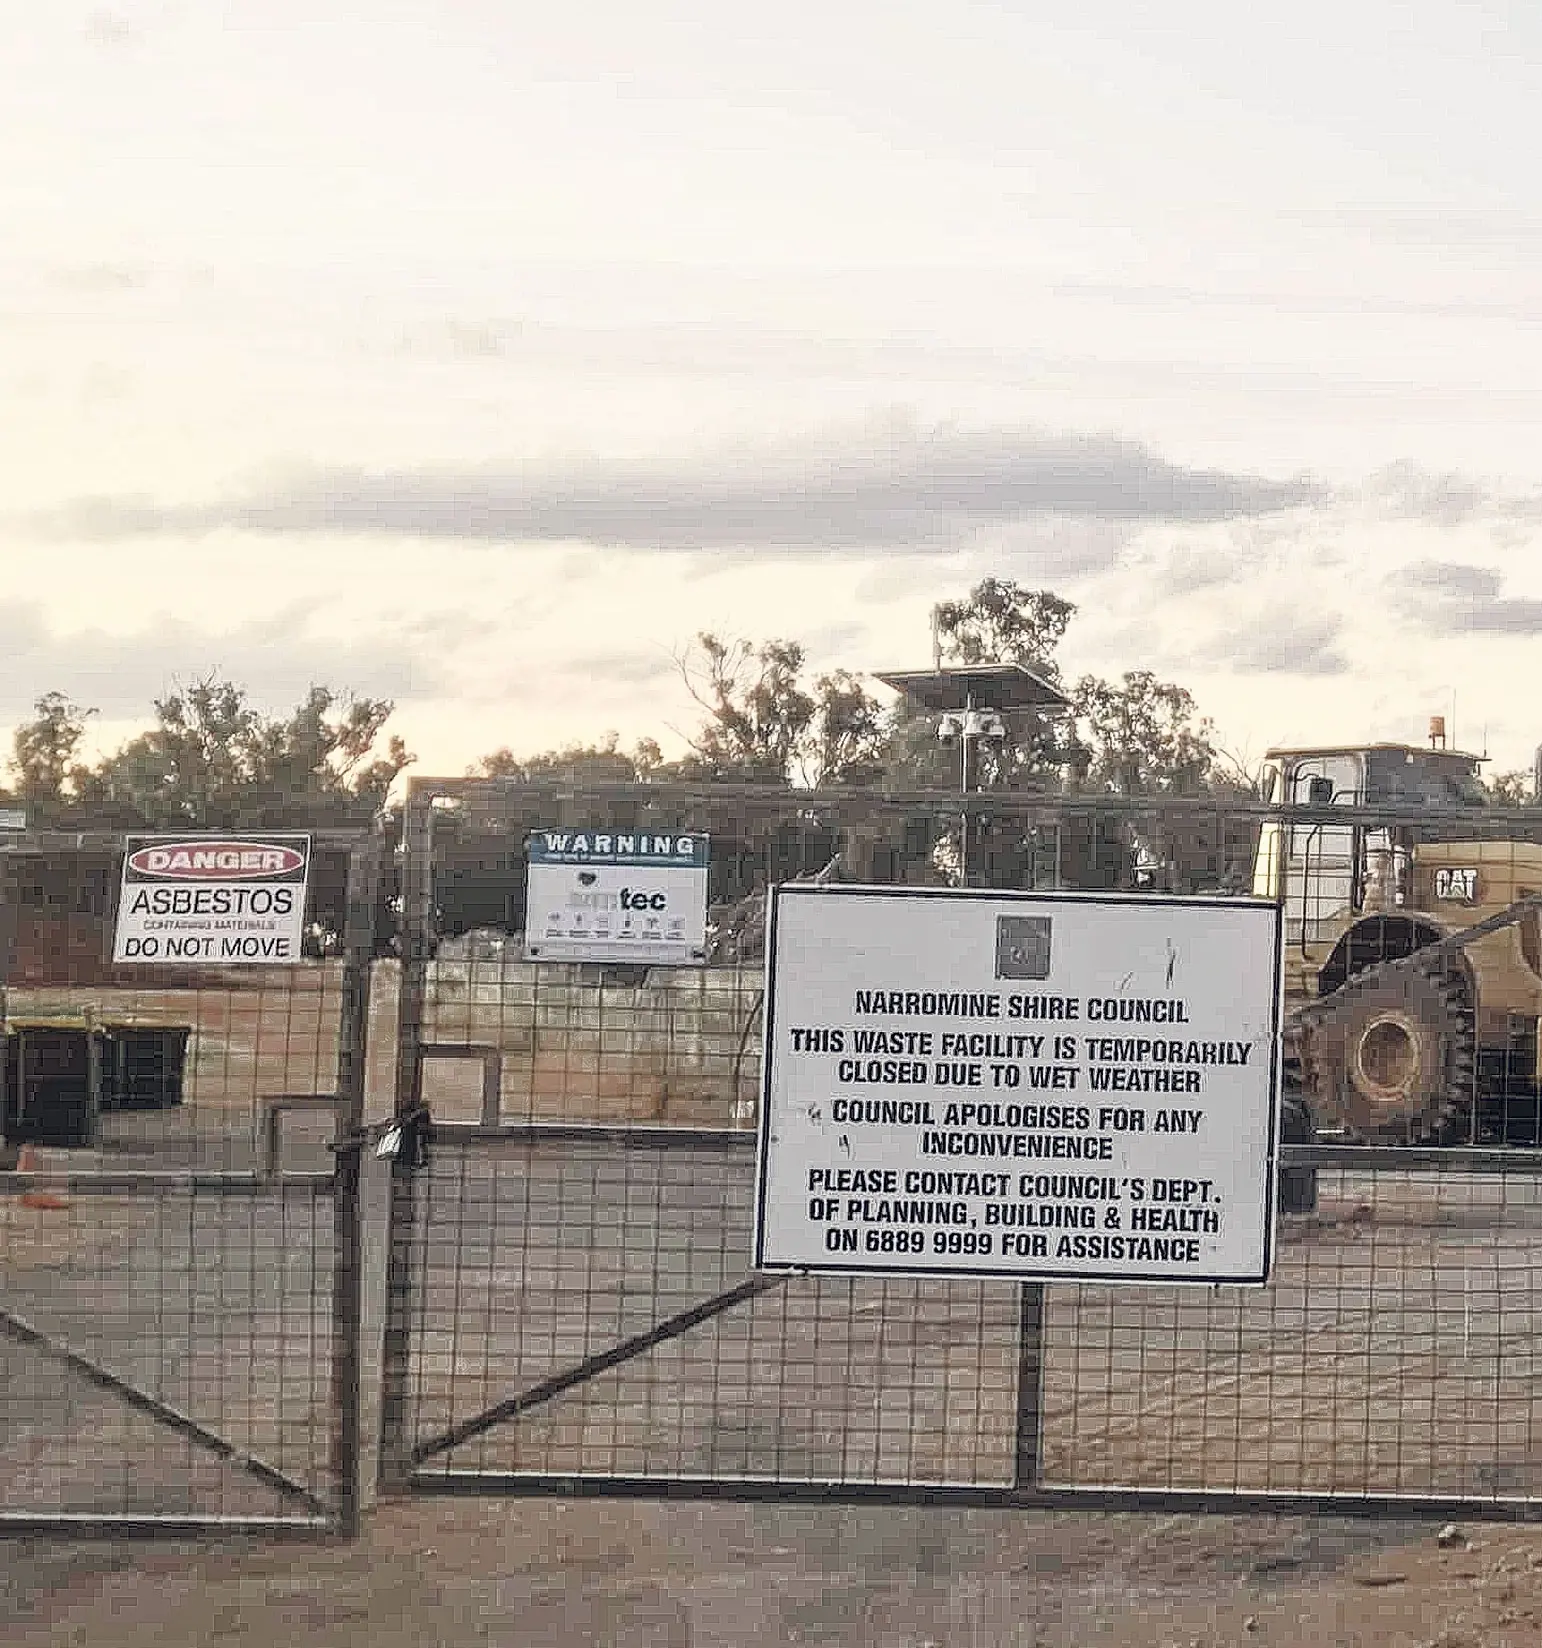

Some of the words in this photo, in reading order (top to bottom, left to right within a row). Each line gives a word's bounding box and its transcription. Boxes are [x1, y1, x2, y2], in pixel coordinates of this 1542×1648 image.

[148, 851, 285, 870] DANGER
[545, 834, 694, 854] WARNING
[130, 888, 292, 915] ASBESTOS
[1436, 870, 1477, 899] CAT
[125, 937, 158, 957] DO
[167, 938, 215, 956] NOT
[221, 938, 290, 957] MOVE
[854, 990, 1000, 1018] NARROMINE
[1007, 995, 1080, 1021] SHIRE
[1088, 998, 1190, 1024] COUNCIL
[791, 1028, 844, 1054] THIS
[854, 1031, 932, 1056] WASTE
[941, 1033, 1045, 1059] FACILITY
[1053, 1037, 1077, 1060] IS
[1085, 1037, 1252, 1066] TEMPORARILY
[838, 1060, 927, 1085] CLOSED
[934, 1062, 982, 1087] DUE
[990, 1064, 1020, 1088] TO
[1028, 1066, 1081, 1090] WET
[1088, 1067, 1201, 1094] WEATHER
[832, 1099, 935, 1126] COUNCIL
[943, 1103, 1090, 1131] APOLOGISES
[1099, 1109, 1145, 1133] FOR
[1153, 1110, 1203, 1134] ANY
[922, 1132, 1113, 1161] INCONVENIENCE
[809, 1169, 897, 1195] PLEASE
[905, 1171, 1011, 1198] CONTACT
[1018, 1174, 1145, 1202] COUNCIL'S
[1152, 1178, 1222, 1204] DEPT.
[809, 1198, 841, 1223] OF
[847, 1200, 977, 1228] PLANNING,
[984, 1203, 1095, 1230] BUILDING
[1103, 1207, 1122, 1231] &
[1131, 1209, 1220, 1234] HEALTH
[826, 1228, 858, 1252] ON
[865, 1229, 925, 1254] 6889
[933, 1231, 993, 1256] 9999
[1001, 1233, 1049, 1258] FOR
[1055, 1235, 1200, 1263] ASSISTANCE
